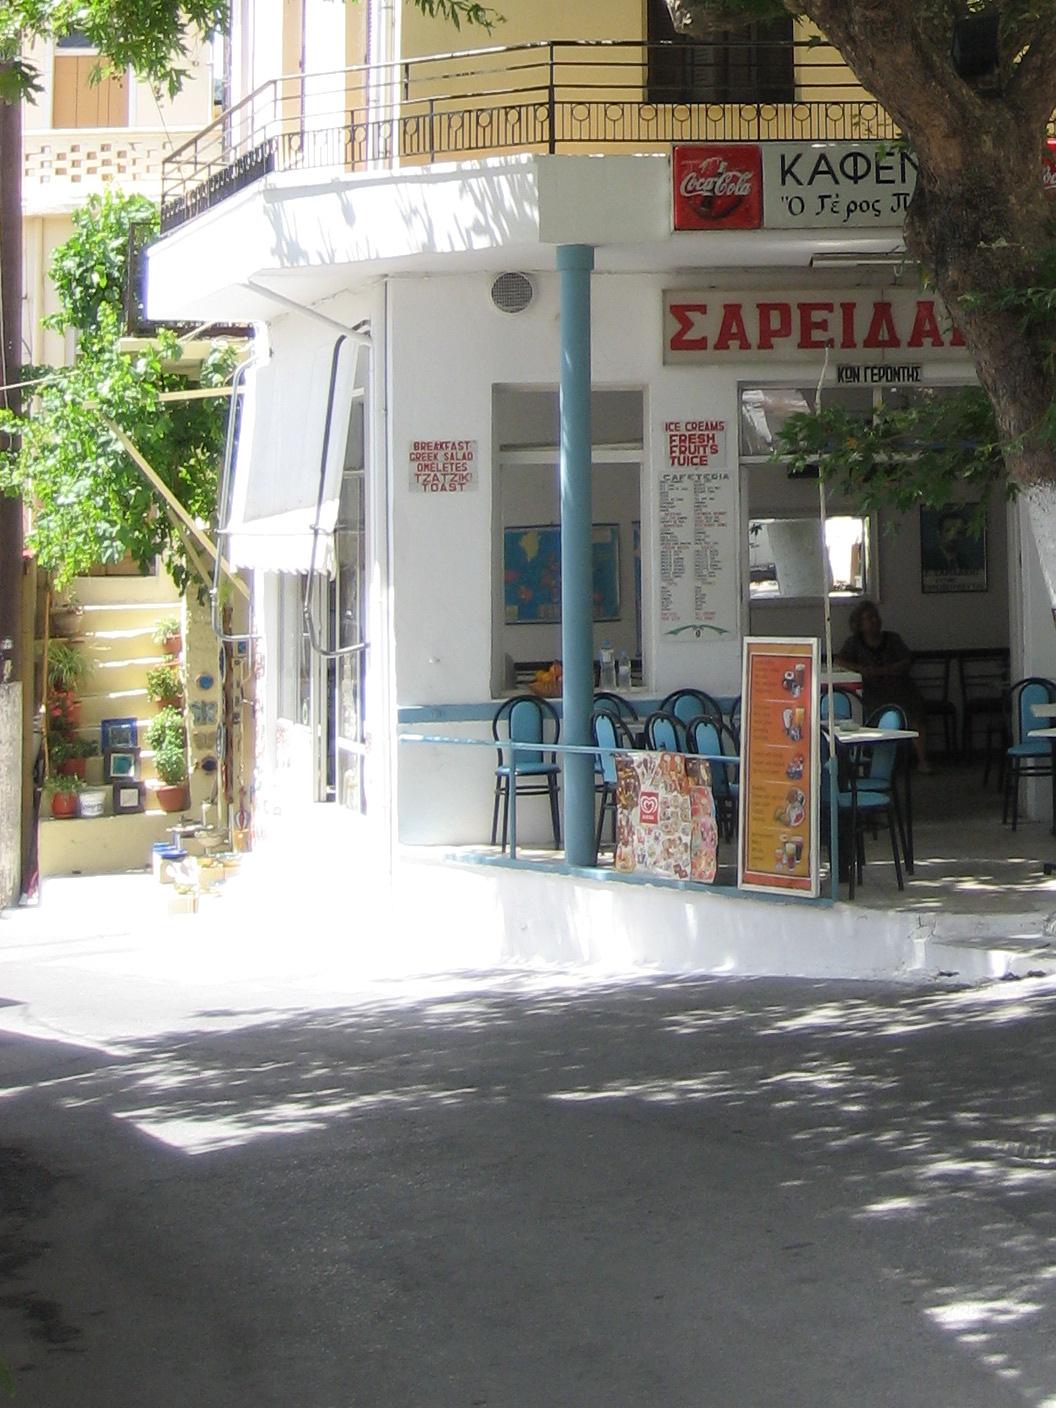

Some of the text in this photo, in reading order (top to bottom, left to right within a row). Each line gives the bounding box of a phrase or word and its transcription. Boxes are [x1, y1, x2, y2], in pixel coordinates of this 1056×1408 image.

[780, 150, 919, 187] ΚΑΦΕΝ
[680, 171, 752, 197] Coca-Cola
[890, 192, 910, 214] Π
[863, 365, 922, 383] ΓΕΡΟΝΤΗΣ
[664, 420, 726, 433] ICE CREAMS
[413, 440, 472, 452] BREAKFAST
[669, 433, 716, 446] FRESH
[443, 451, 474, 462] SALAD
[669, 444, 719, 456] FRUITS
[416, 462, 469, 473] OMELETES
[421, 482, 467, 493] TOAST
